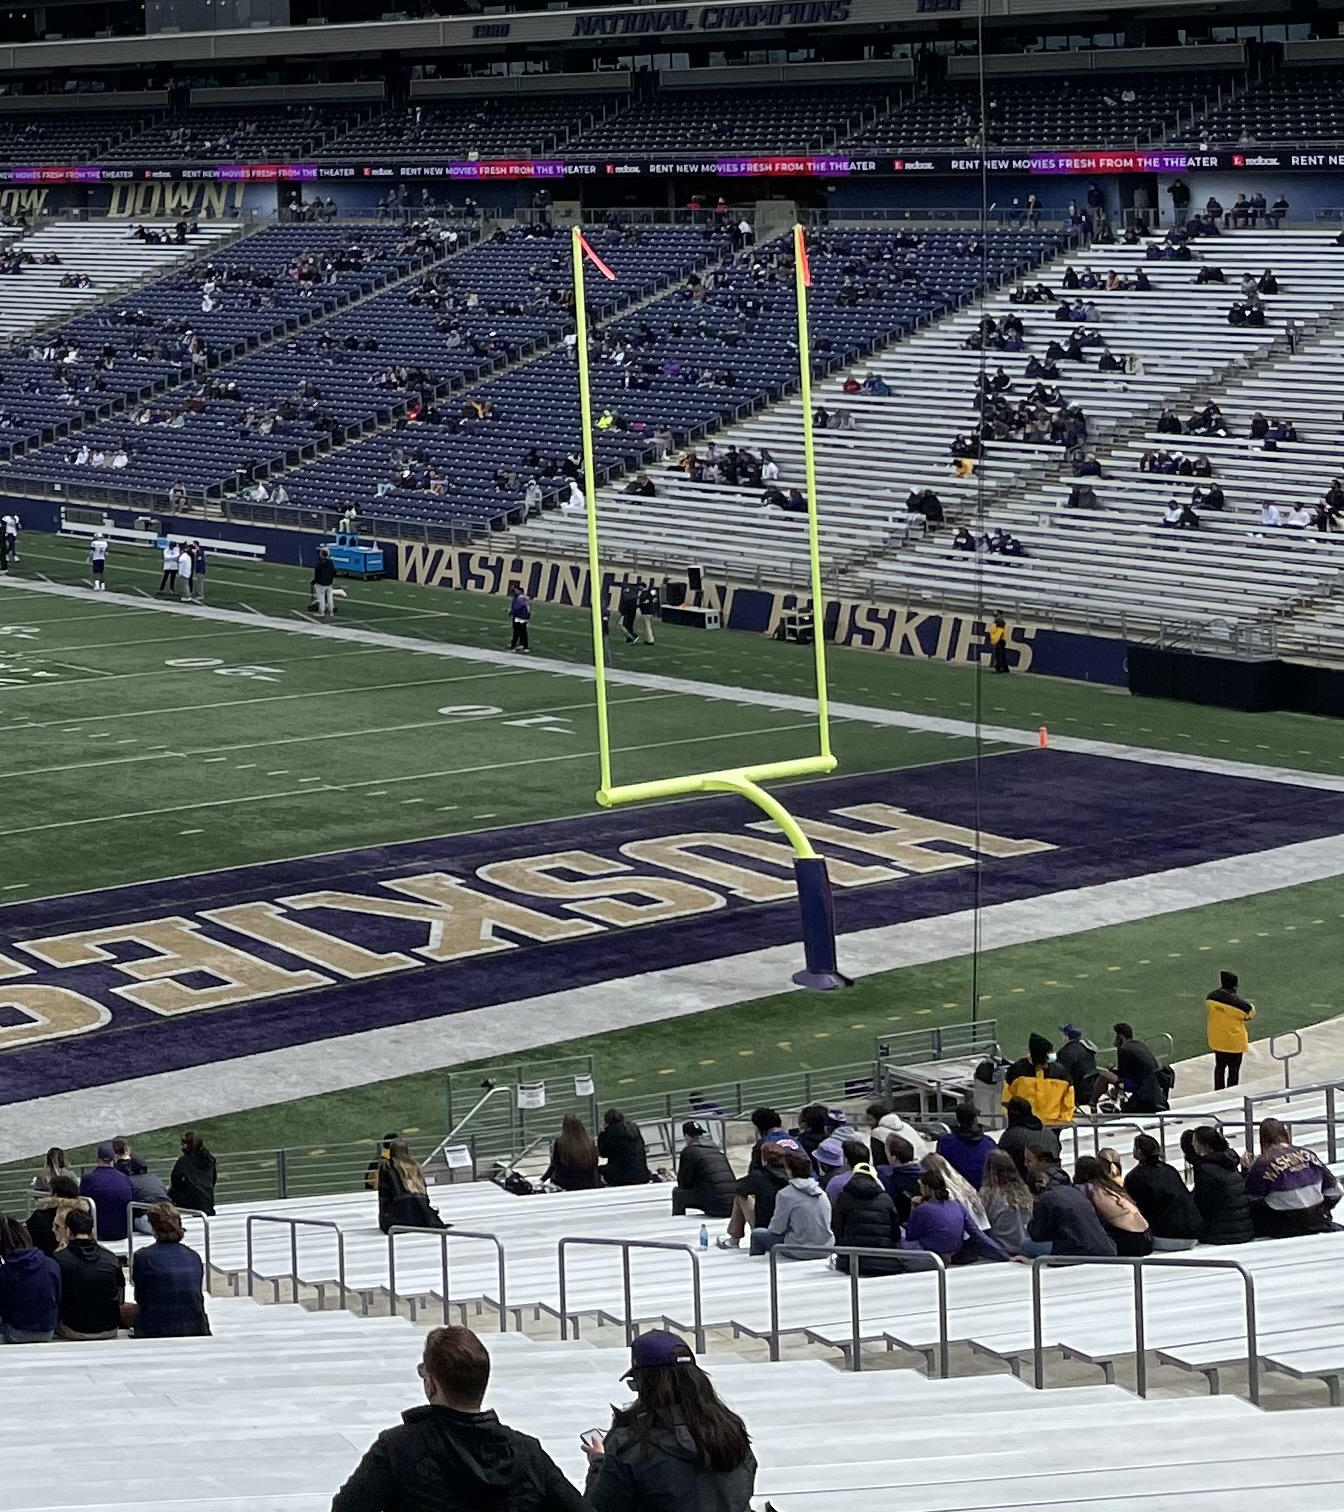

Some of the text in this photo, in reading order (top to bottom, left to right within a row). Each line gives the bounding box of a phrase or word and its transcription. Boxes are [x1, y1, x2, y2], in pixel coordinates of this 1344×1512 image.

[571, 9, 694, 37] NATIONAL
[951, 156, 1218, 170] RENT NEW MOVIES FRESH FROM THE THEATER
[1291, 155, 1324, 166] RENT
[400, 167, 422, 176] RENT
[424, 167, 443, 176] NEW
[446, 166, 478, 176] MOVIES
[479, 166, 507, 176] FRESH
[509, 166, 535, 175] FROM
[537, 165, 554, 175] THE
[556, 165, 597, 175] THEATER
[649, 161, 876, 174] RENT NEW MOVIES FRESH FROM THE THEATER
